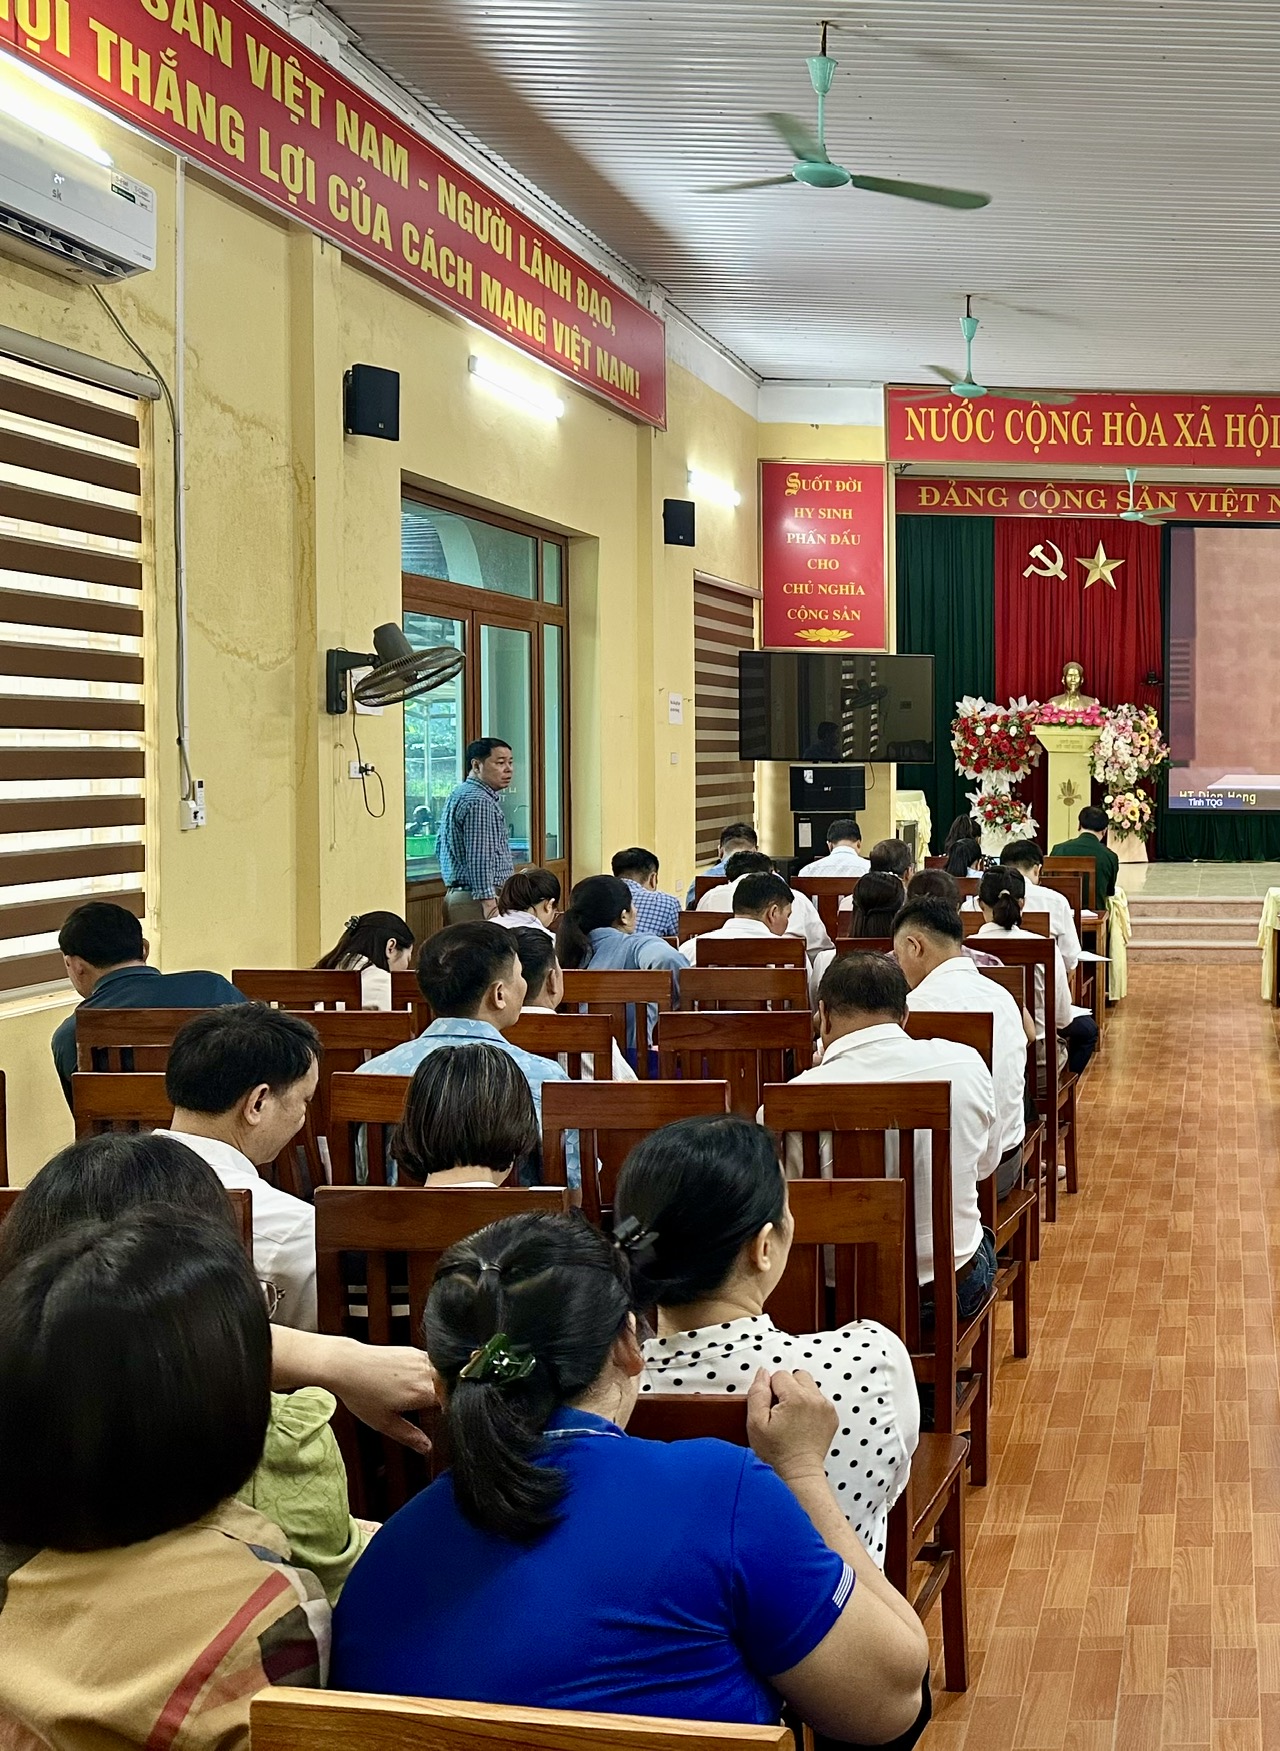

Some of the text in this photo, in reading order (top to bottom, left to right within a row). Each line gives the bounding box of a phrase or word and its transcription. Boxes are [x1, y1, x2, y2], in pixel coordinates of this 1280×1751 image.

[246, 34, 325, 129] VIỆT
[336, 100, 409, 189] NAM
[437, 175, 512, 261] NGƯỜI
[519, 235, 572, 303] LÃNH
[576, 277, 616, 337] ĐẠO,
[89, 17, 244, 162] THẮNG
[260, 127, 316, 204] LỢI
[328, 175, 393, 252] CỦA
[402, 222, 473, 300] CÁCH
[480, 271, 547, 346] MẠNG
[551, 317, 592, 373] VIỆT
[596, 346, 640, 400] NAM!
[904, 398, 995, 444] NƯỚC
[1005, 401, 1094, 454] CỘNG
[1102, 403, 1169, 447] HÒA
[1173, 405, 1217, 447] XÃ
[784, 472, 863, 496] SUỐT ĐỜI
[918, 480, 1009, 508] ĐẢNG
[1018, 483, 1108, 514] CỘNG
[1116, 485, 1178, 511] SẢN
[1186, 487, 1260, 514] VIỆT
[793, 508, 853, 520] HY SINH
[786, 528, 861, 546] PHẤN ĐẤU
[807, 558, 840, 570] CHO
[783, 580, 866, 596] CHỦ NGHĨA
[787, 604, 861, 622] CỘNG SẢN
[1206, 798, 1223, 808] TQG
